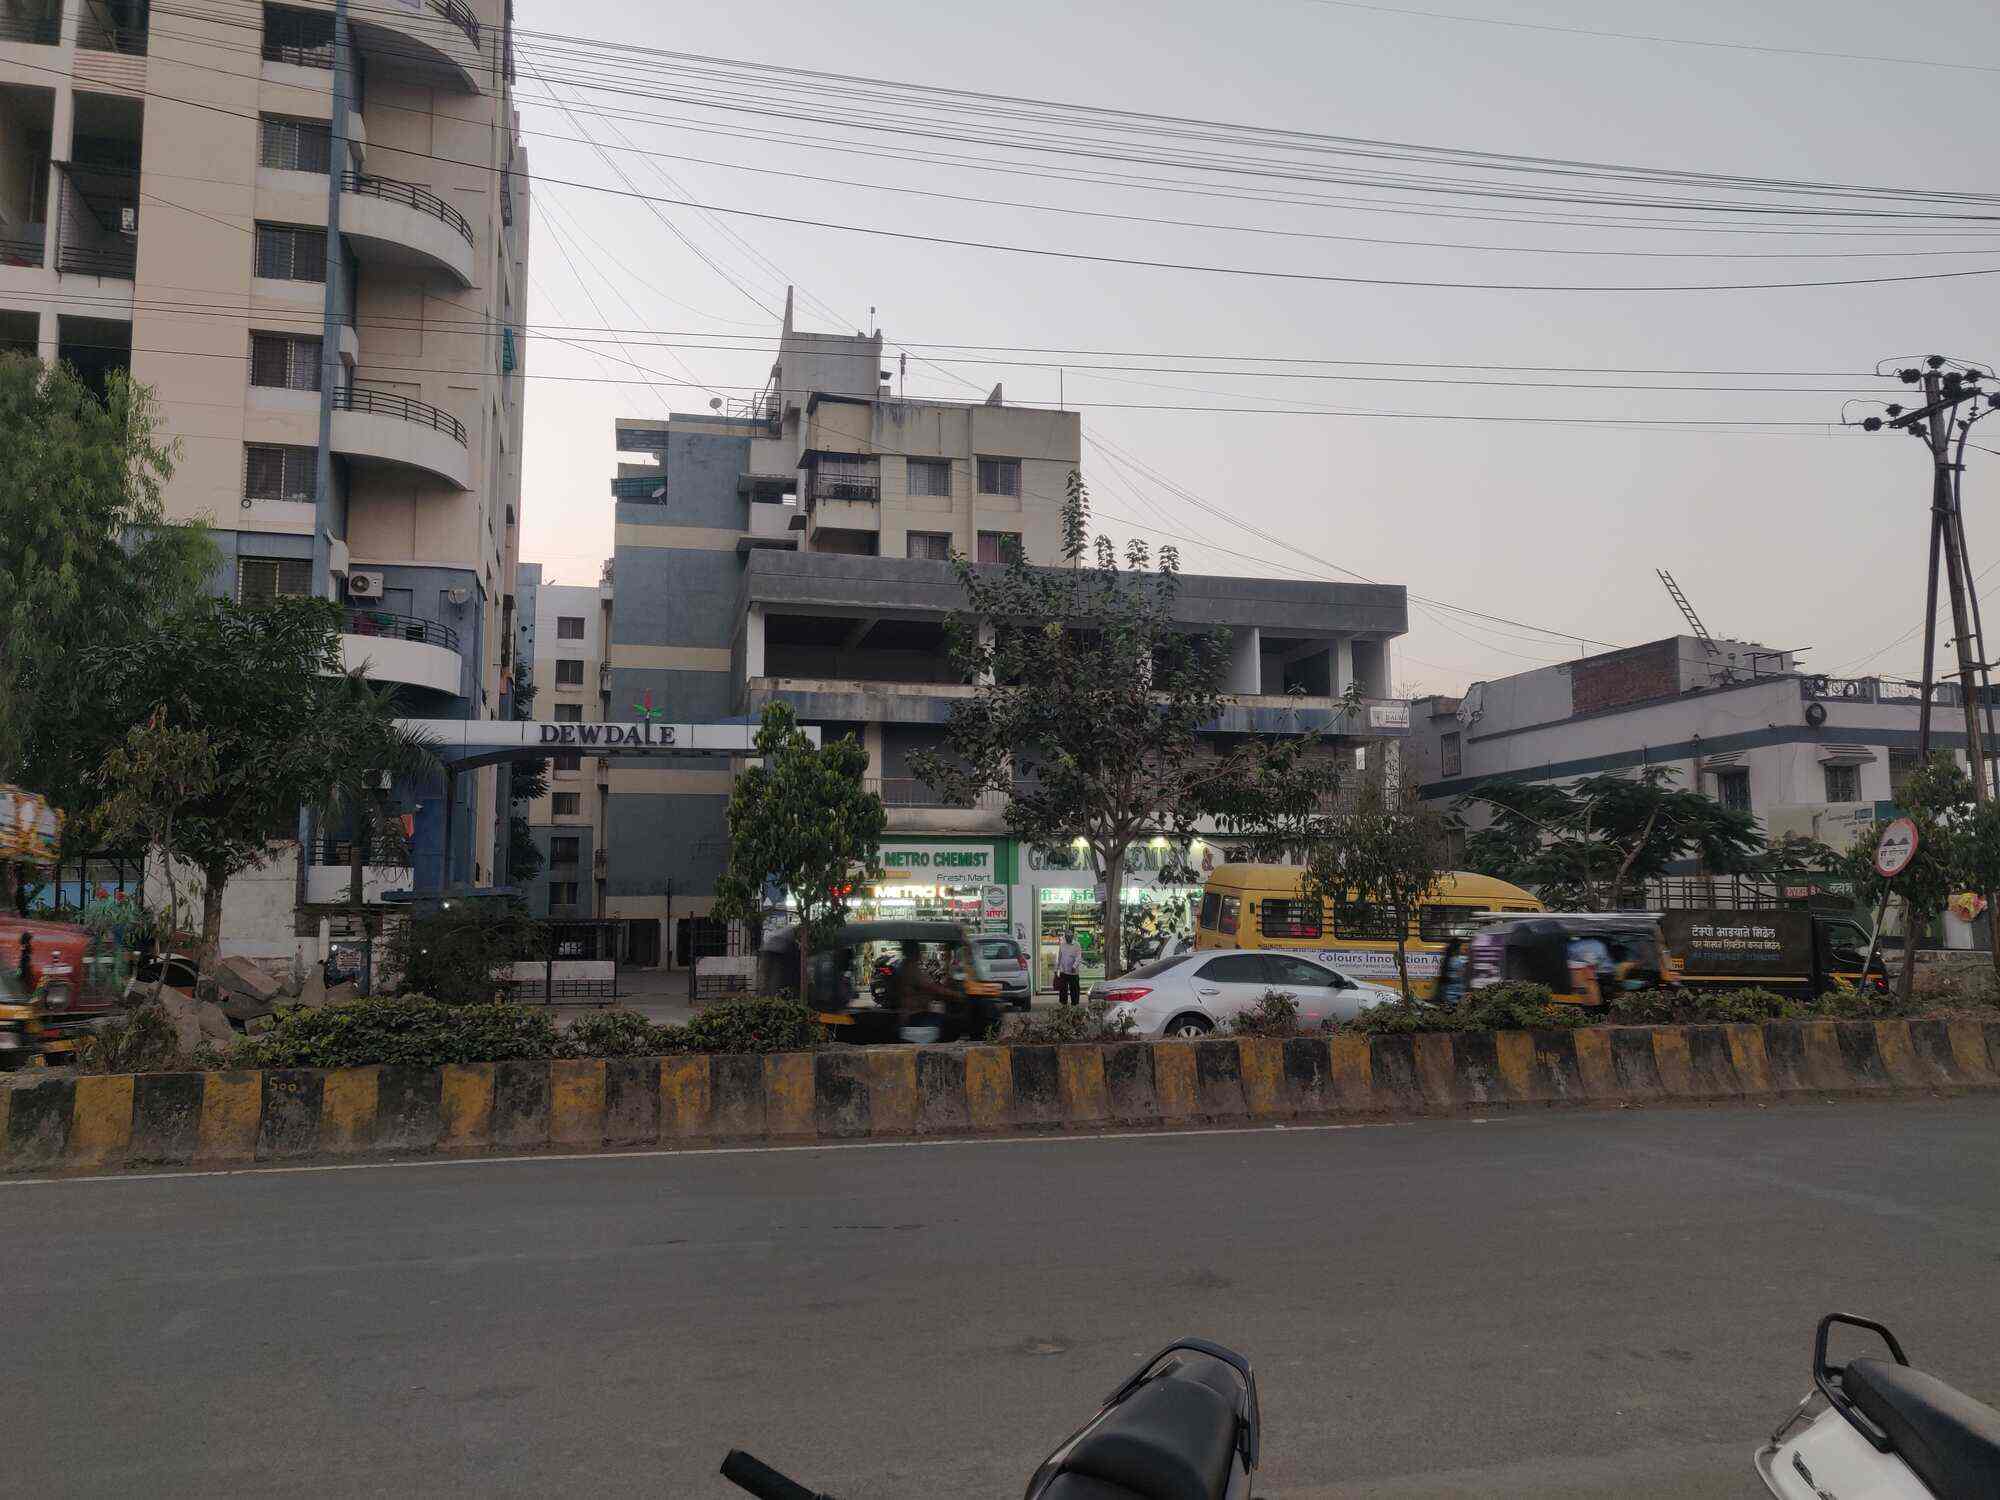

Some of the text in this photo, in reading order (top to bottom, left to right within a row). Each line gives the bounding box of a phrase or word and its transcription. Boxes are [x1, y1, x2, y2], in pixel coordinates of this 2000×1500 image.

[539, 720, 676, 745] DEWDALE
[884, 851, 930, 867] METRO
[933, 851, 989, 867] CHEMIST
[936, 873, 991, 882] Fresh Mart
[1318, 952, 1363, 964] Colours
[1366, 952, 1428, 964] Innotion
